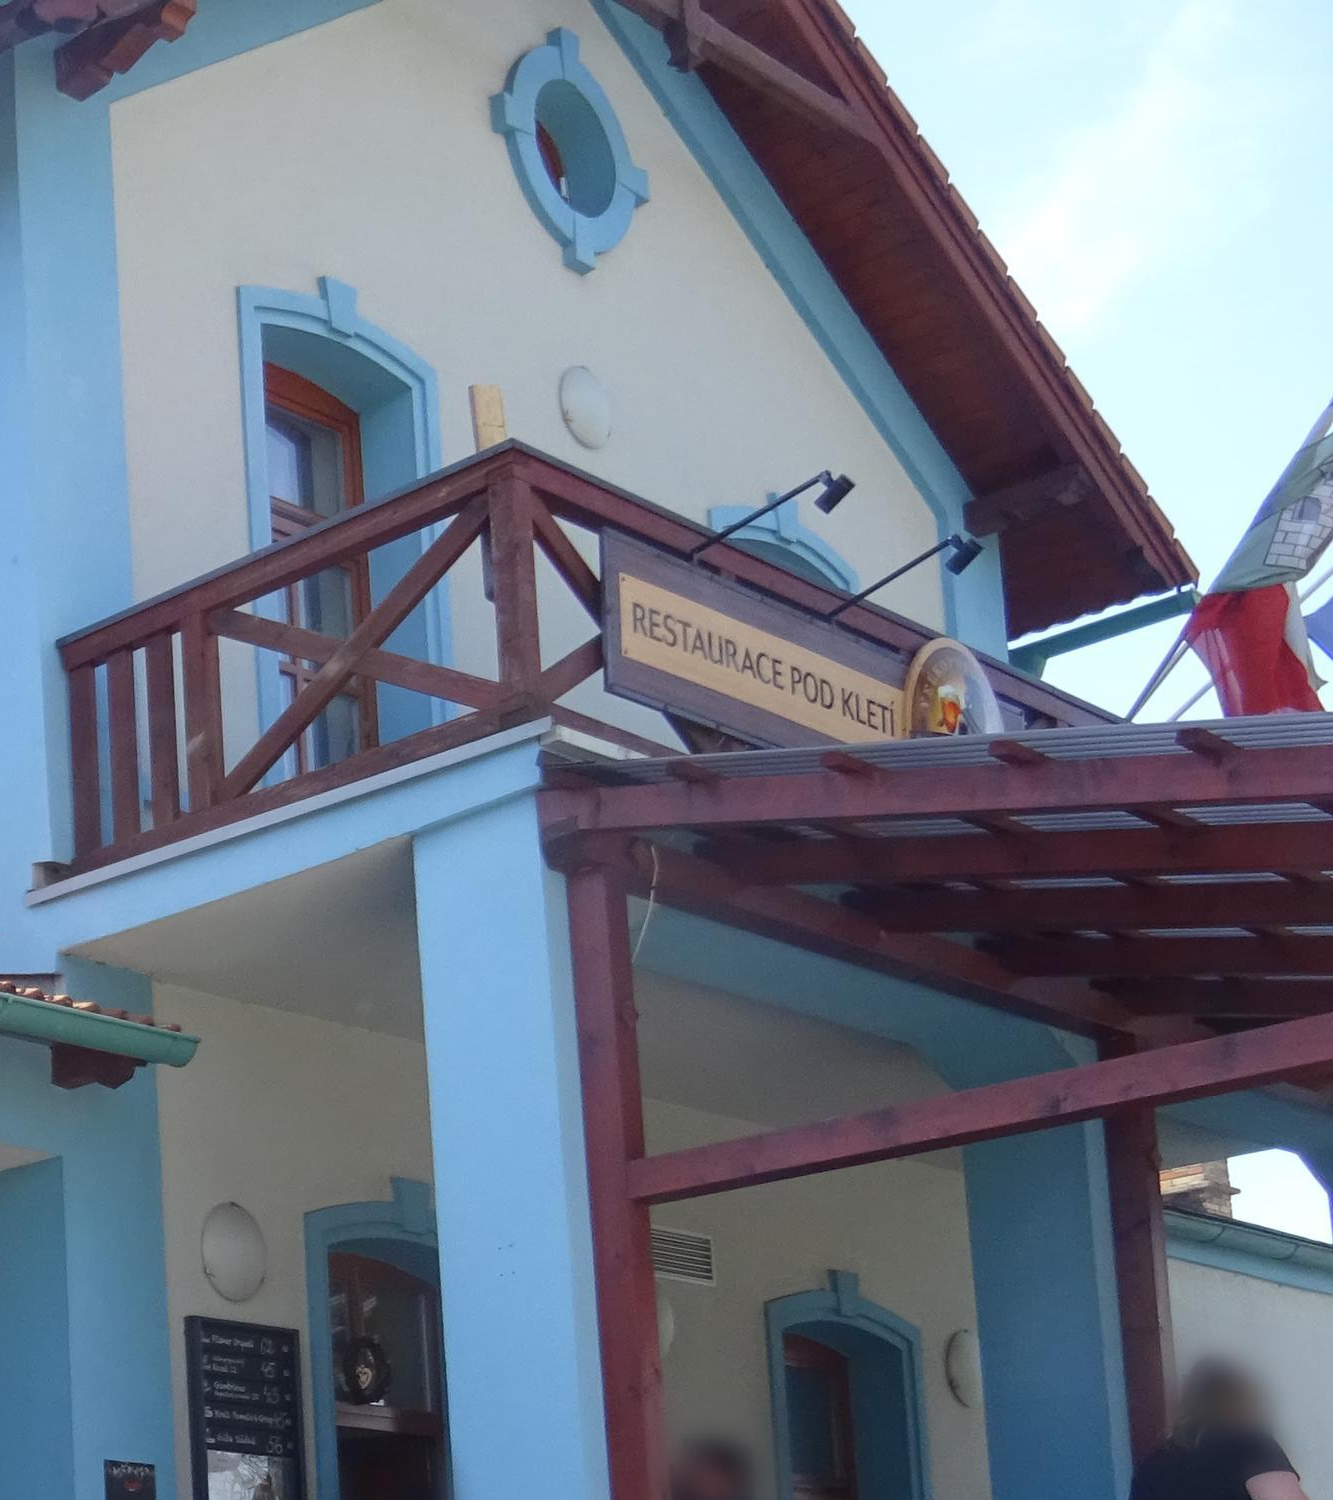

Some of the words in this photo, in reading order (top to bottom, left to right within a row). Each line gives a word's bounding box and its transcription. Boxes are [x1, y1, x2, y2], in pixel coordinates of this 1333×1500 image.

[632, 602, 784, 690] RESTAURACE
[790, 665, 834, 710] POD
[841, 688, 895, 737] KLETÍ
